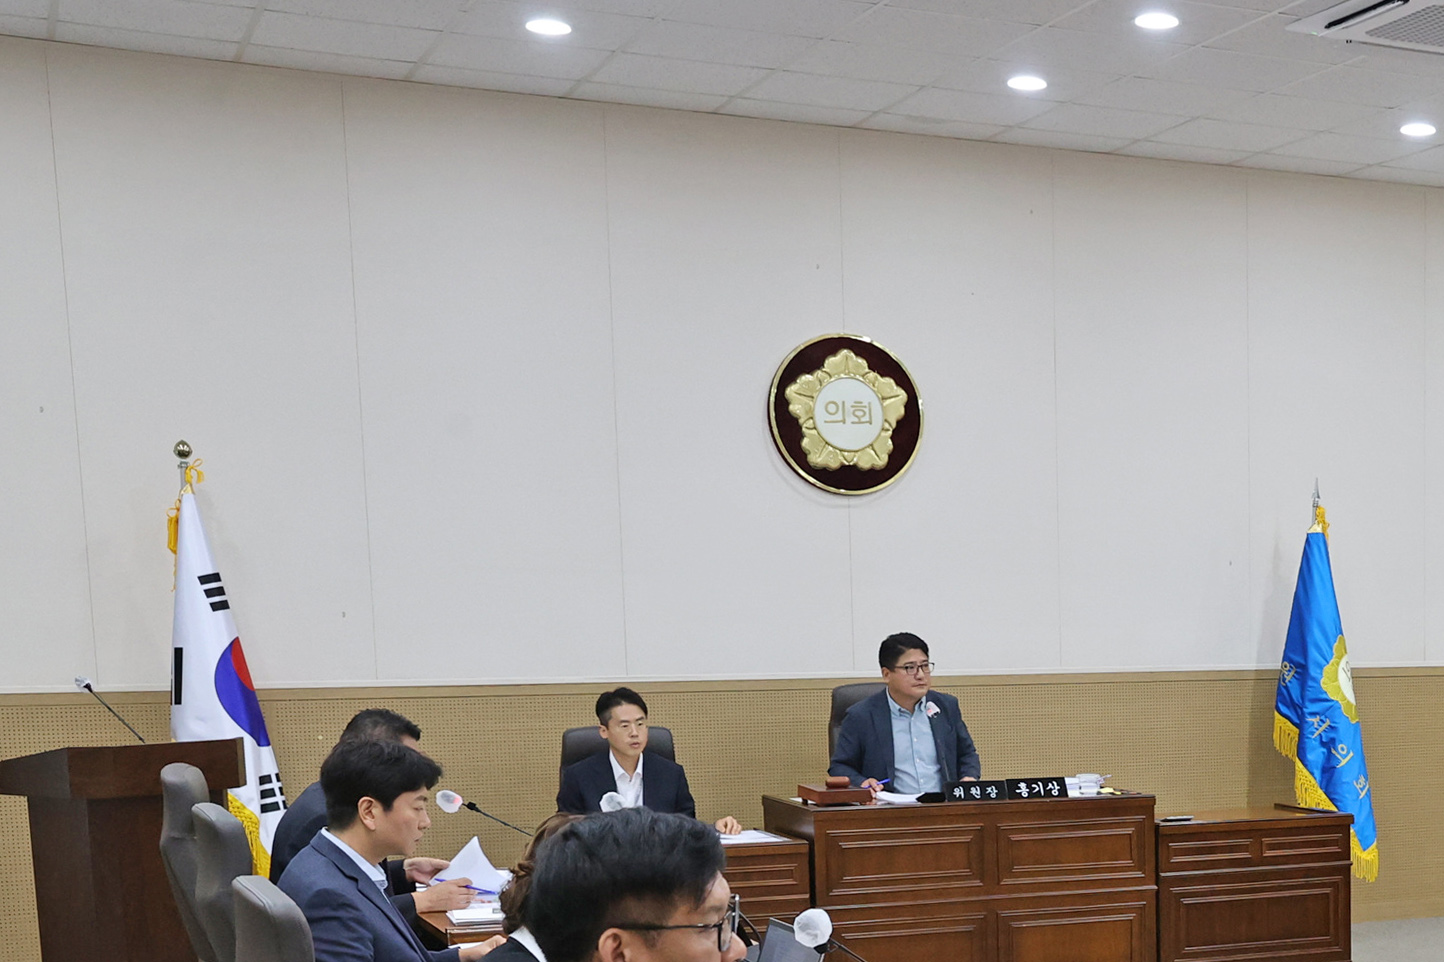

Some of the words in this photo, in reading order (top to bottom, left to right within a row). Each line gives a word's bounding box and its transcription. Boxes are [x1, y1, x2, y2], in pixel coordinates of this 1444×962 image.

[823, 400, 873, 425] 의회
[952, 785, 999, 799] 위원장
[1014, 781, 1061, 797] 홍기상
